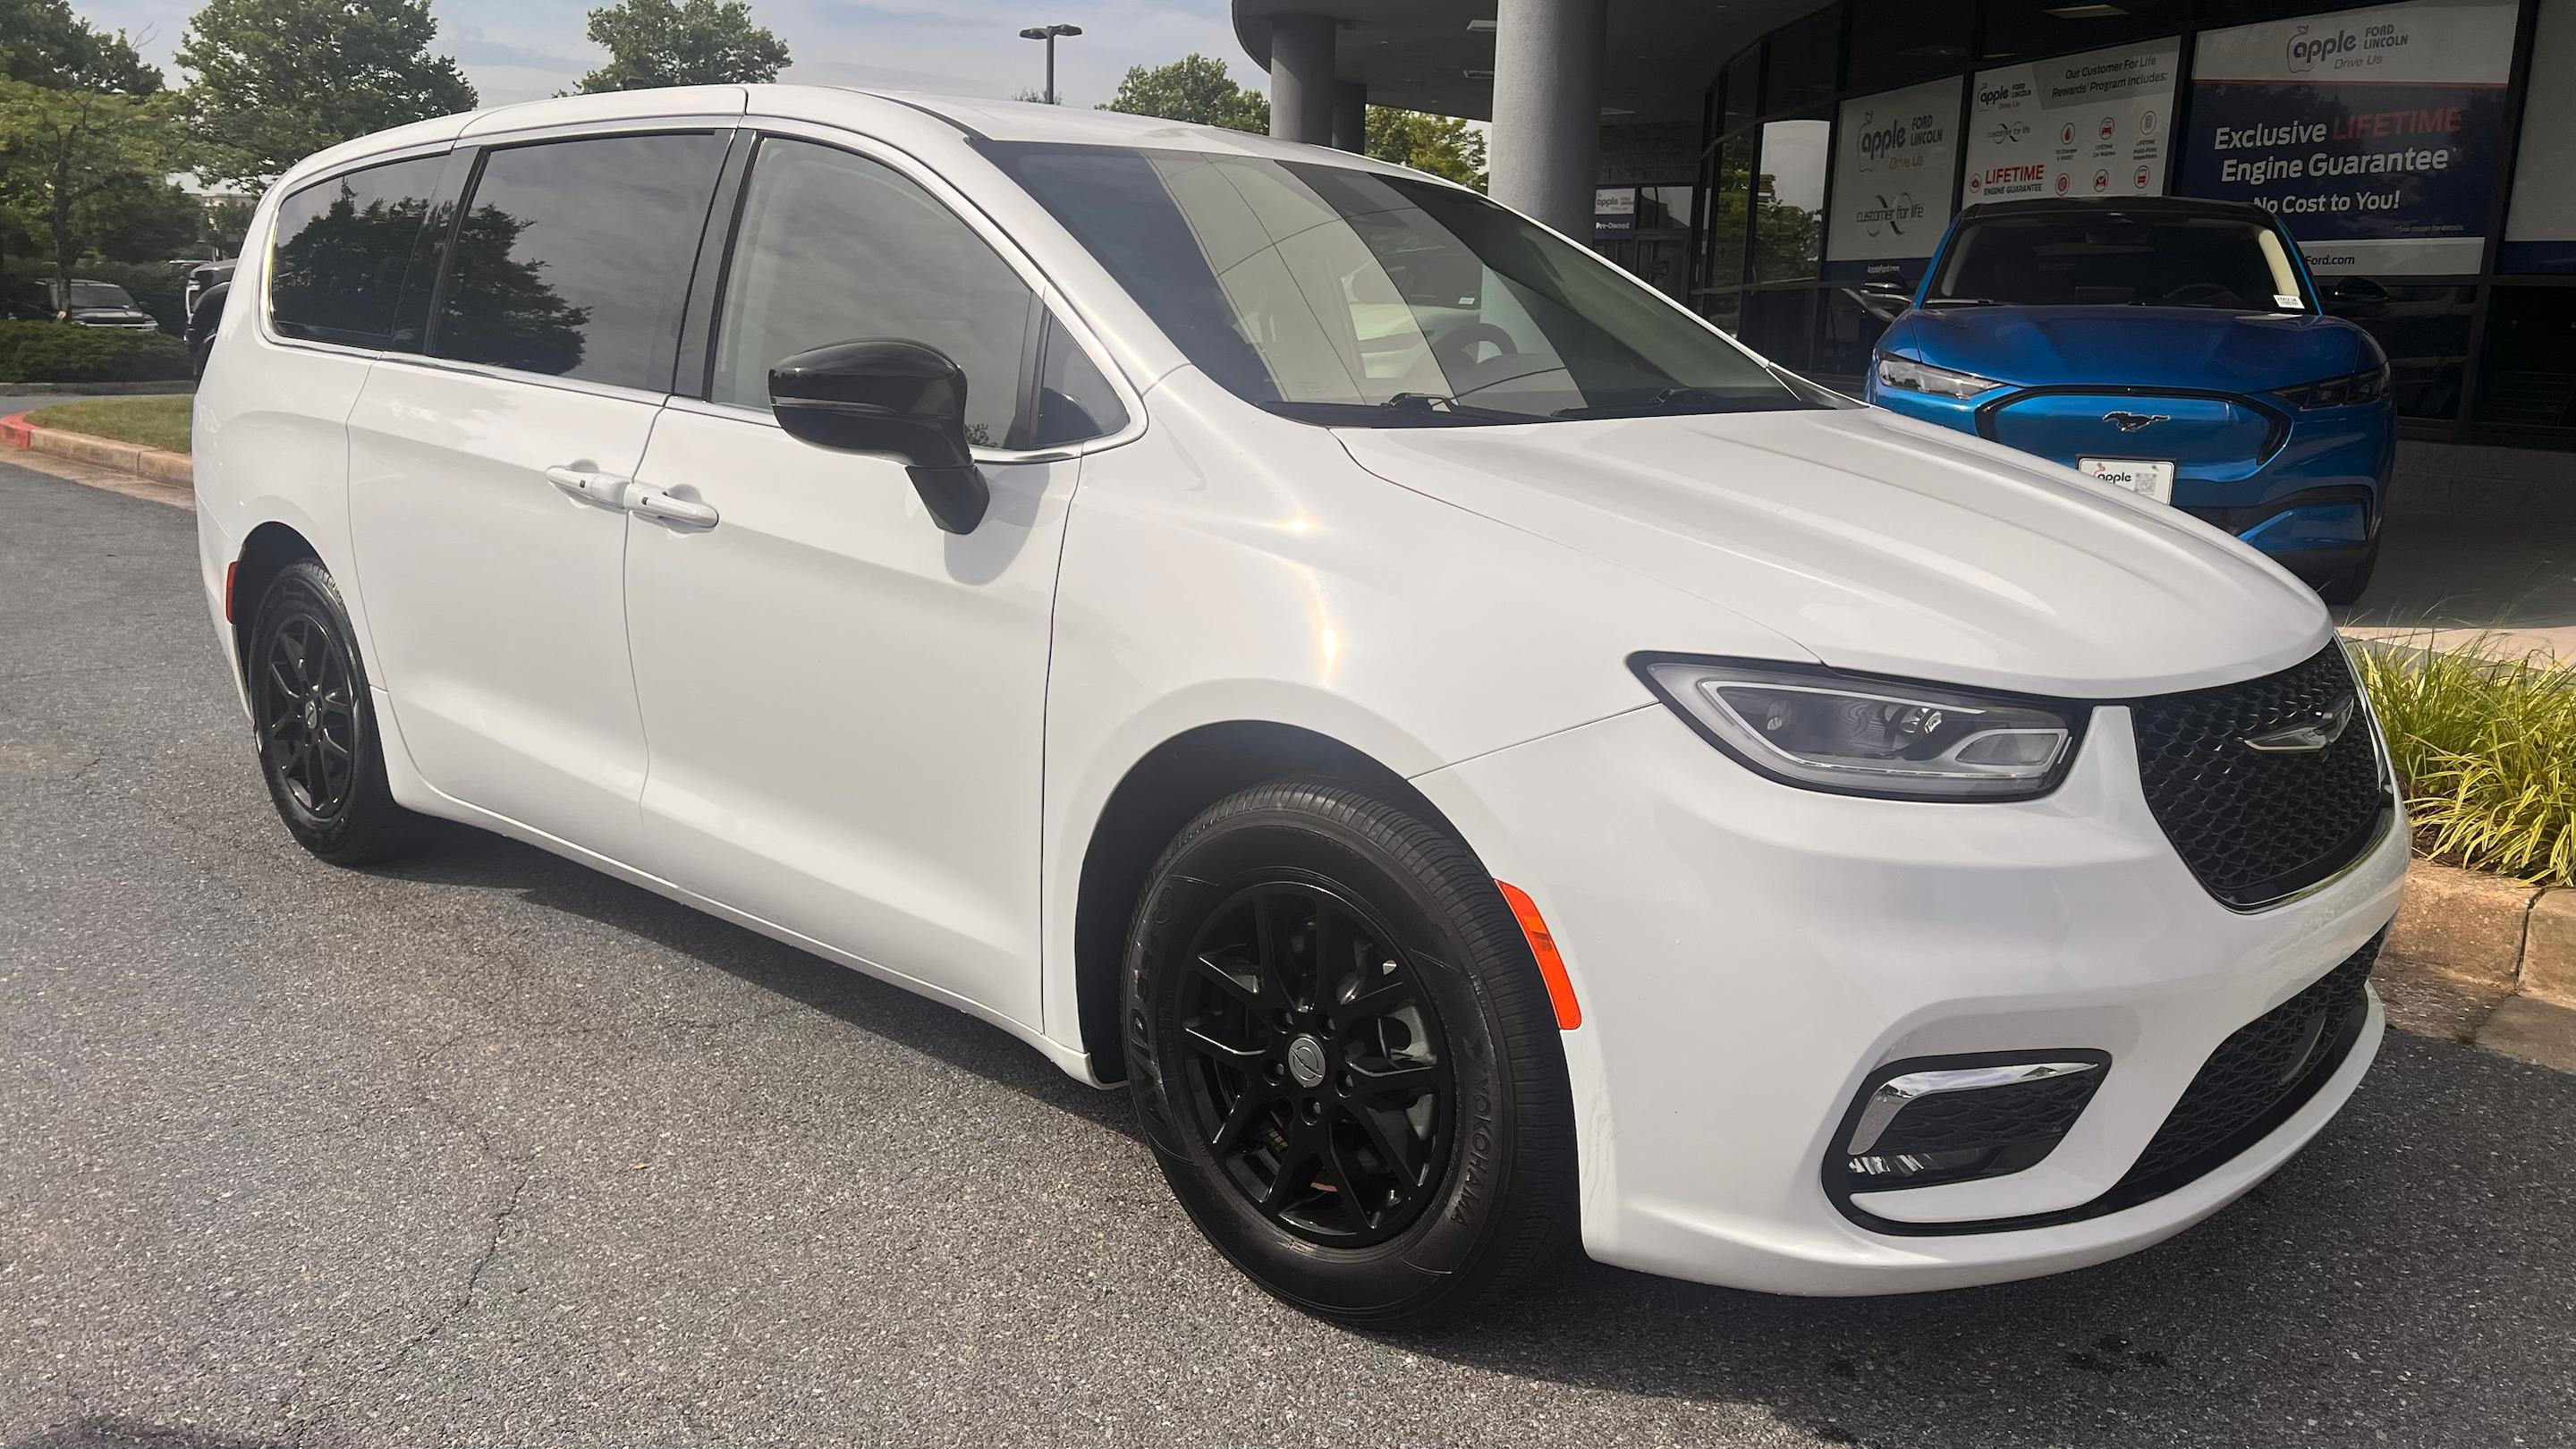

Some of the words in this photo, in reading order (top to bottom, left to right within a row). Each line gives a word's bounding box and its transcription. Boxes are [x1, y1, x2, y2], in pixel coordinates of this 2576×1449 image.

[2365, 24, 2394, 38] FORD
[2292, 30, 2357, 64] apple
[2363, 34, 2409, 50] LINCOLN
[2065, 70, 2080, 80] Our
[2081, 62, 2123, 77] Customer
[2124, 59, 2139, 71] For
[2140, 55, 2157, 67] Life
[2334, 57, 2363, 70] Drive
[2367, 54, 2383, 65] Us
[2089, 78, 2126, 92] Program
[2128, 71, 2168, 86] Includes:
[1980, 86, 2009, 106] apple
[1911, 114, 1933, 131] FORD
[2214, 120, 2326, 150] Exclusive
[2332, 106, 2462, 140] LIFETIME
[1861, 120, 1906, 160] apple
[1911, 129, 1943, 147] LINCOLN
[1889, 156, 1910, 170] Drive
[1912, 155, 1924, 167] Us
[2221, 155, 2303, 185] Engine
[1986, 164, 2045, 184] LIFETIME
[1984, 187, 2004, 196] ENGINE
[2005, 183, 2043, 194] GUARANTEE
[2252, 196, 2278, 215] No
[2282, 193, 2326, 214] Cost
[2330, 192, 2351, 212] to
[2356, 190, 2401, 211] You!
[1856, 208, 1894, 223] customer
[1896, 205, 1910, 220] for
[1911, 205, 1925, 218] life
[1449, 1077, 1493, 1230] YOKOHAMA
